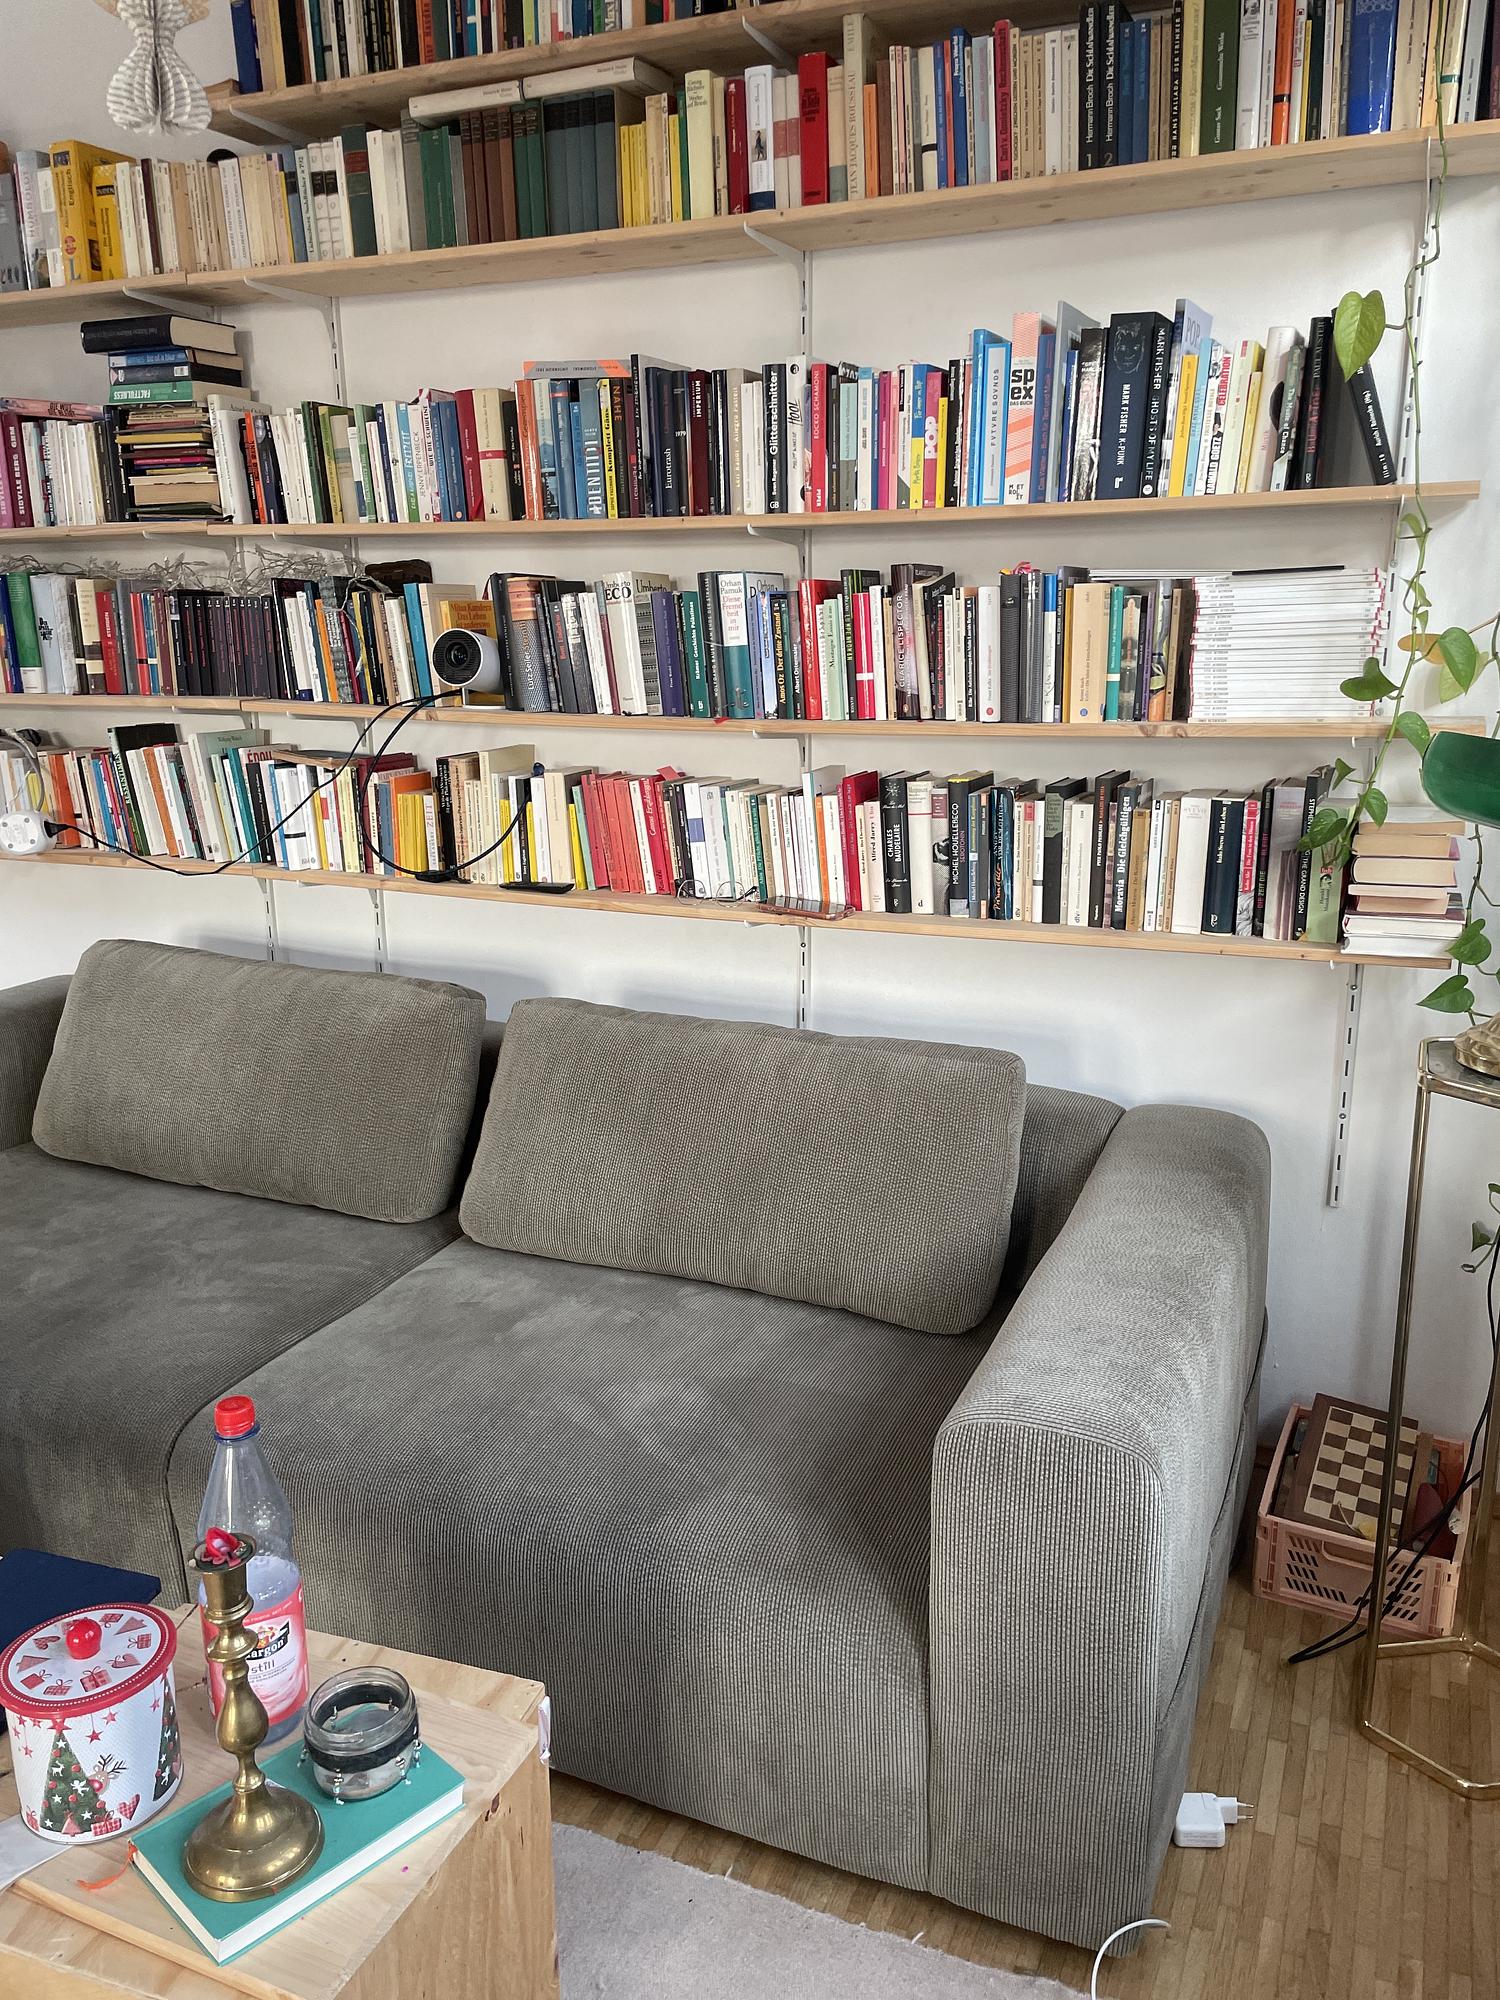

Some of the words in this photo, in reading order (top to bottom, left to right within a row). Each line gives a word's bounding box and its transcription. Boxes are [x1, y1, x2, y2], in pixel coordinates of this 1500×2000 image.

[1086, 84, 1094, 107] Broch
[1106, 83, 1114, 107] Broch
[1086, 109, 1094, 143] Hermann
[1156, 327, 1166, 355] MARK
[1316, 321, 1324, 355] AUSTER
[1011, 368, 1035, 384] sp
[1313, 357, 1321, 378] PAUL
[113, 389, 150, 400] FACTFULNESS
[613, 385, 621, 421] NAHE
[1010, 385, 1034, 400] ex
[1121, 384, 1131, 405] MARK
[769, 371, 778, 455] Glitterschnitter
[788, 400, 803, 425] HOOL
[1210, 436, 1222, 460] GOETZ
[1216, 356, 1231, 406] CELEBRATION
[423, 405, 431, 439] SCHWEINE
[1119, 407, 1129, 434] FISHER
[924, 416, 938, 459] POP
[1148, 433, 1156, 445] OF
[413, 431, 423, 473] ERPENBECK
[605, 433, 613, 473] Komplett
[1117, 438, 1126, 465] K-PUNK
[1146, 445, 1155, 460] MY
[13, 453, 21, 477] BERG
[664, 448, 672, 489] Eurotrash
[1145, 462, 1154, 480] LIFE
[418, 475, 426, 497] JENNY
[769, 501, 779, 509] GB
[605, 587, 632, 600] ECO
[720, 579, 742, 588] Orhan
[720, 586, 743, 595] Pamuk
[523, 651, 532, 672] Seiler
[778, 673, 785, 684] Oz
[1307, 798, 1315, 825] STEPHEN
[951, 803, 959, 856] HOUELLEBECQ
[1118, 796, 1131, 858] Gleichgültigen
[894, 824, 902, 862] BAUDELAIRE
[1116, 859, 1125, 873] Die
[1115, 879, 1124, 912] Moravia
[246, 1639, 284, 1660] argon
[251, 1660, 275, 1674] still
